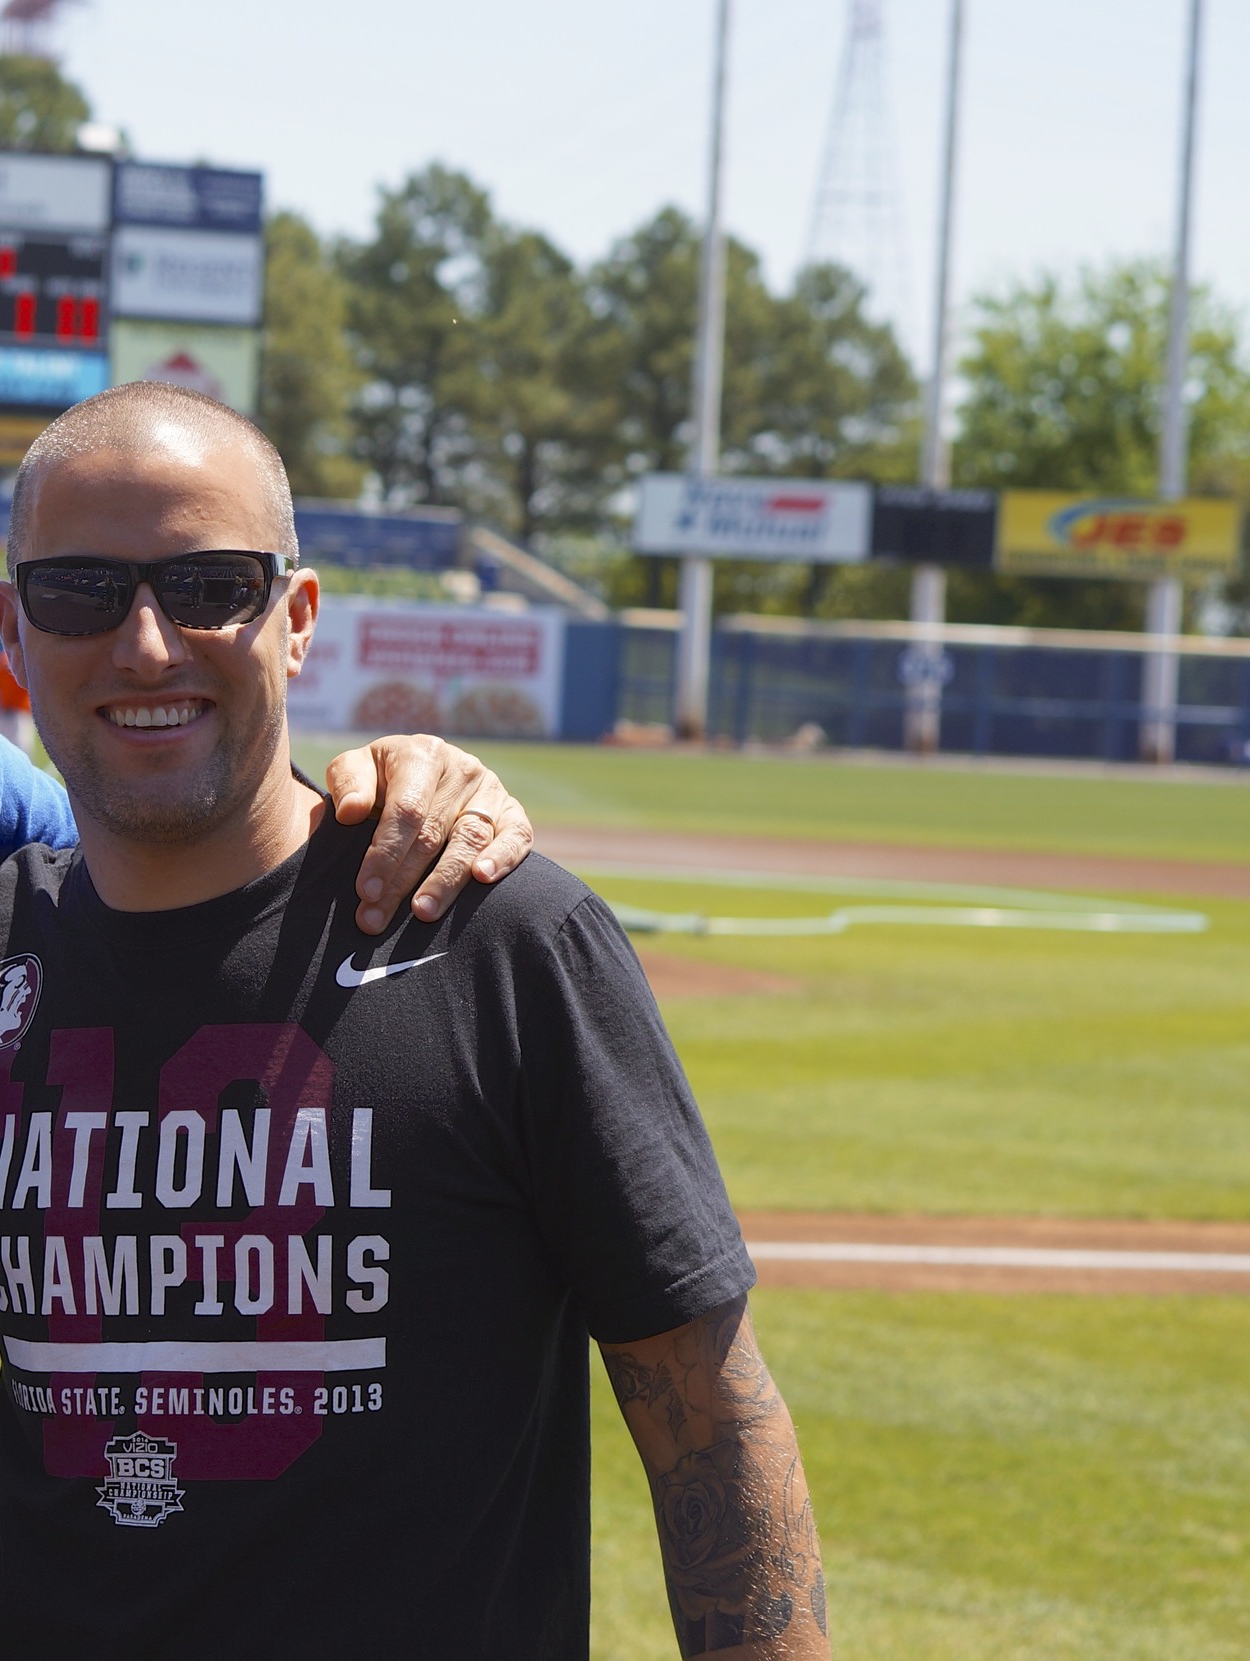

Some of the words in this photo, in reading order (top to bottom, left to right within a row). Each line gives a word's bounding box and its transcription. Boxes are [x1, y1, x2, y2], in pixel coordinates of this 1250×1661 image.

[61, 1387, 120, 1415] STATE
[135, 1387, 294, 1416] SEMINOLES
[313, 1383, 383, 1415] 2013
[122, 1442, 158, 1453] VIZIO
[117, 1458, 165, 1478] BCS
[120, 1482, 162, 1491] NATIONAL
[108, 1488, 173, 1500] CHAMPIONSHIP
